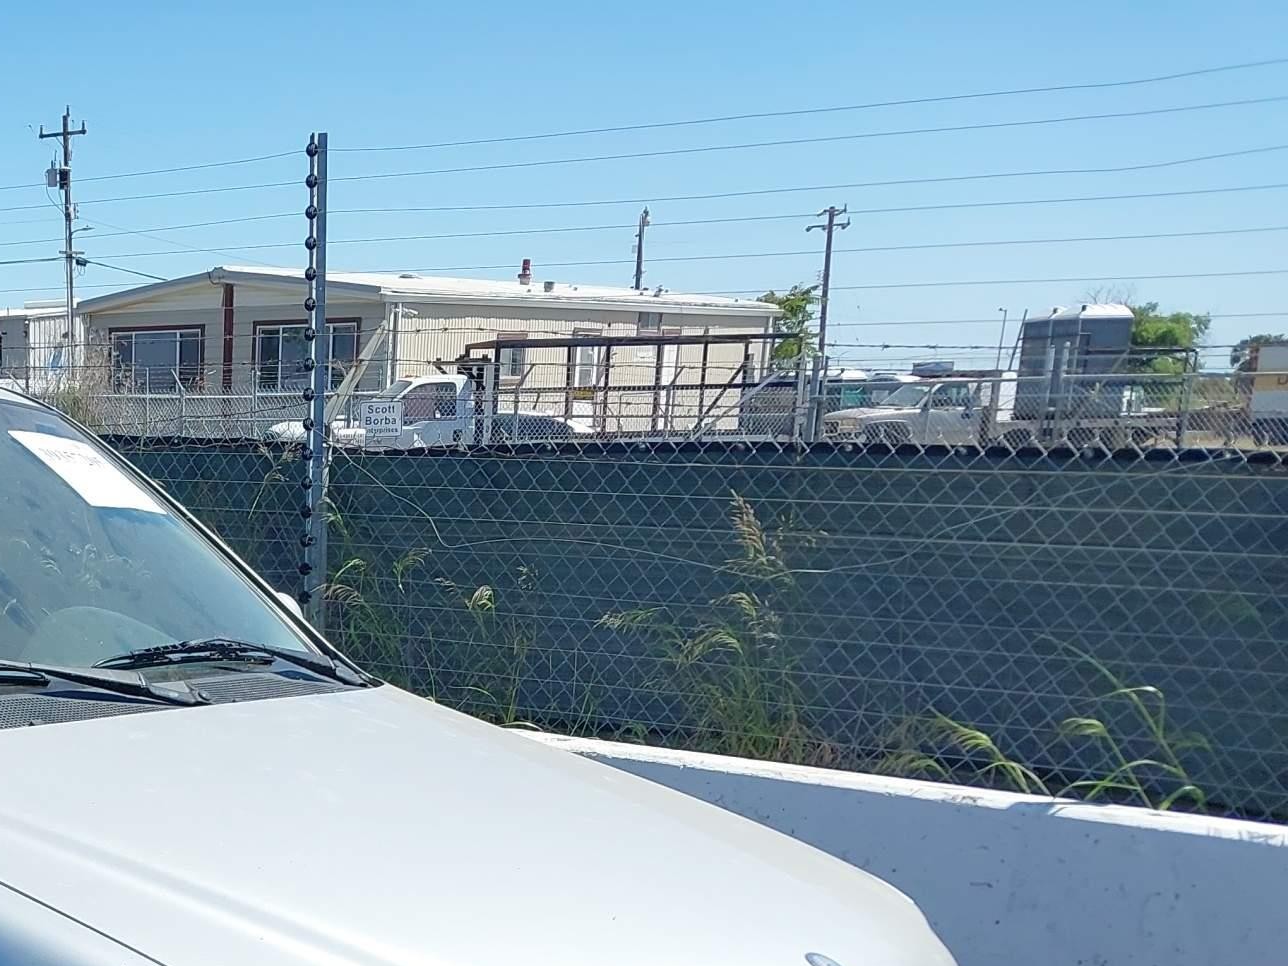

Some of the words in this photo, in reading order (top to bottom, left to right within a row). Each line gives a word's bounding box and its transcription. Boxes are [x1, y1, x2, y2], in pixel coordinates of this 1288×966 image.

[367, 404, 395, 414] Scott
[365, 415, 397, 426] Borba
[364, 426, 399, 434] nterprises
